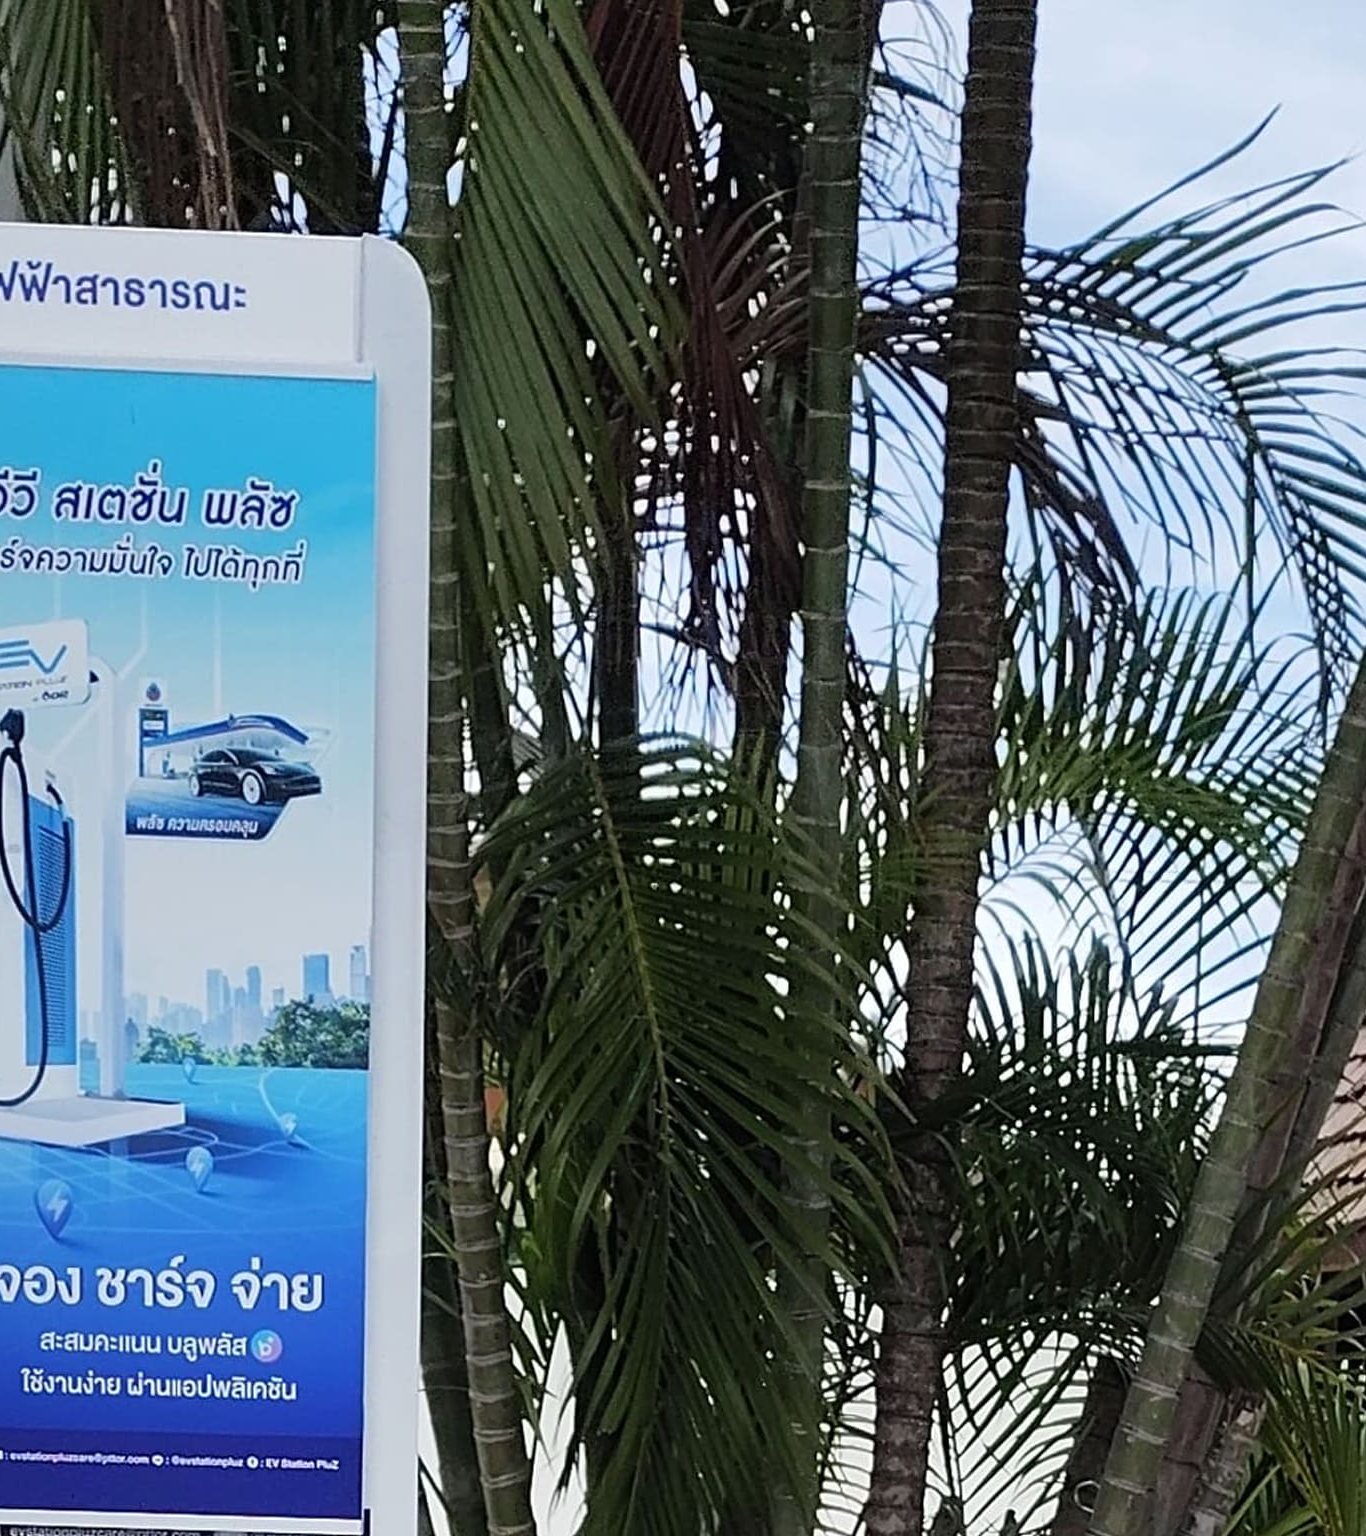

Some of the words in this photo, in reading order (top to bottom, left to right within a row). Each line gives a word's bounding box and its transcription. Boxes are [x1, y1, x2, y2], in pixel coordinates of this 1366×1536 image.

[52, 463, 188, 525] สเตชั่น
[203, 478, 298, 530] พลัซ
[183, 544, 305, 591] ไปได้ทุกที่
[97, 1256, 217, 1307] ชาร์จ
[231, 1257, 324, 1311] จ่าย
[41, 1332, 160, 1353] สะสมคะแนน
[168, 1333, 248, 1361] บลูพลัส
[21, 1368, 120, 1394] ใช้งานง่าย
[128, 1372, 296, 1400] ผ่านแอปพลิเคชัน
